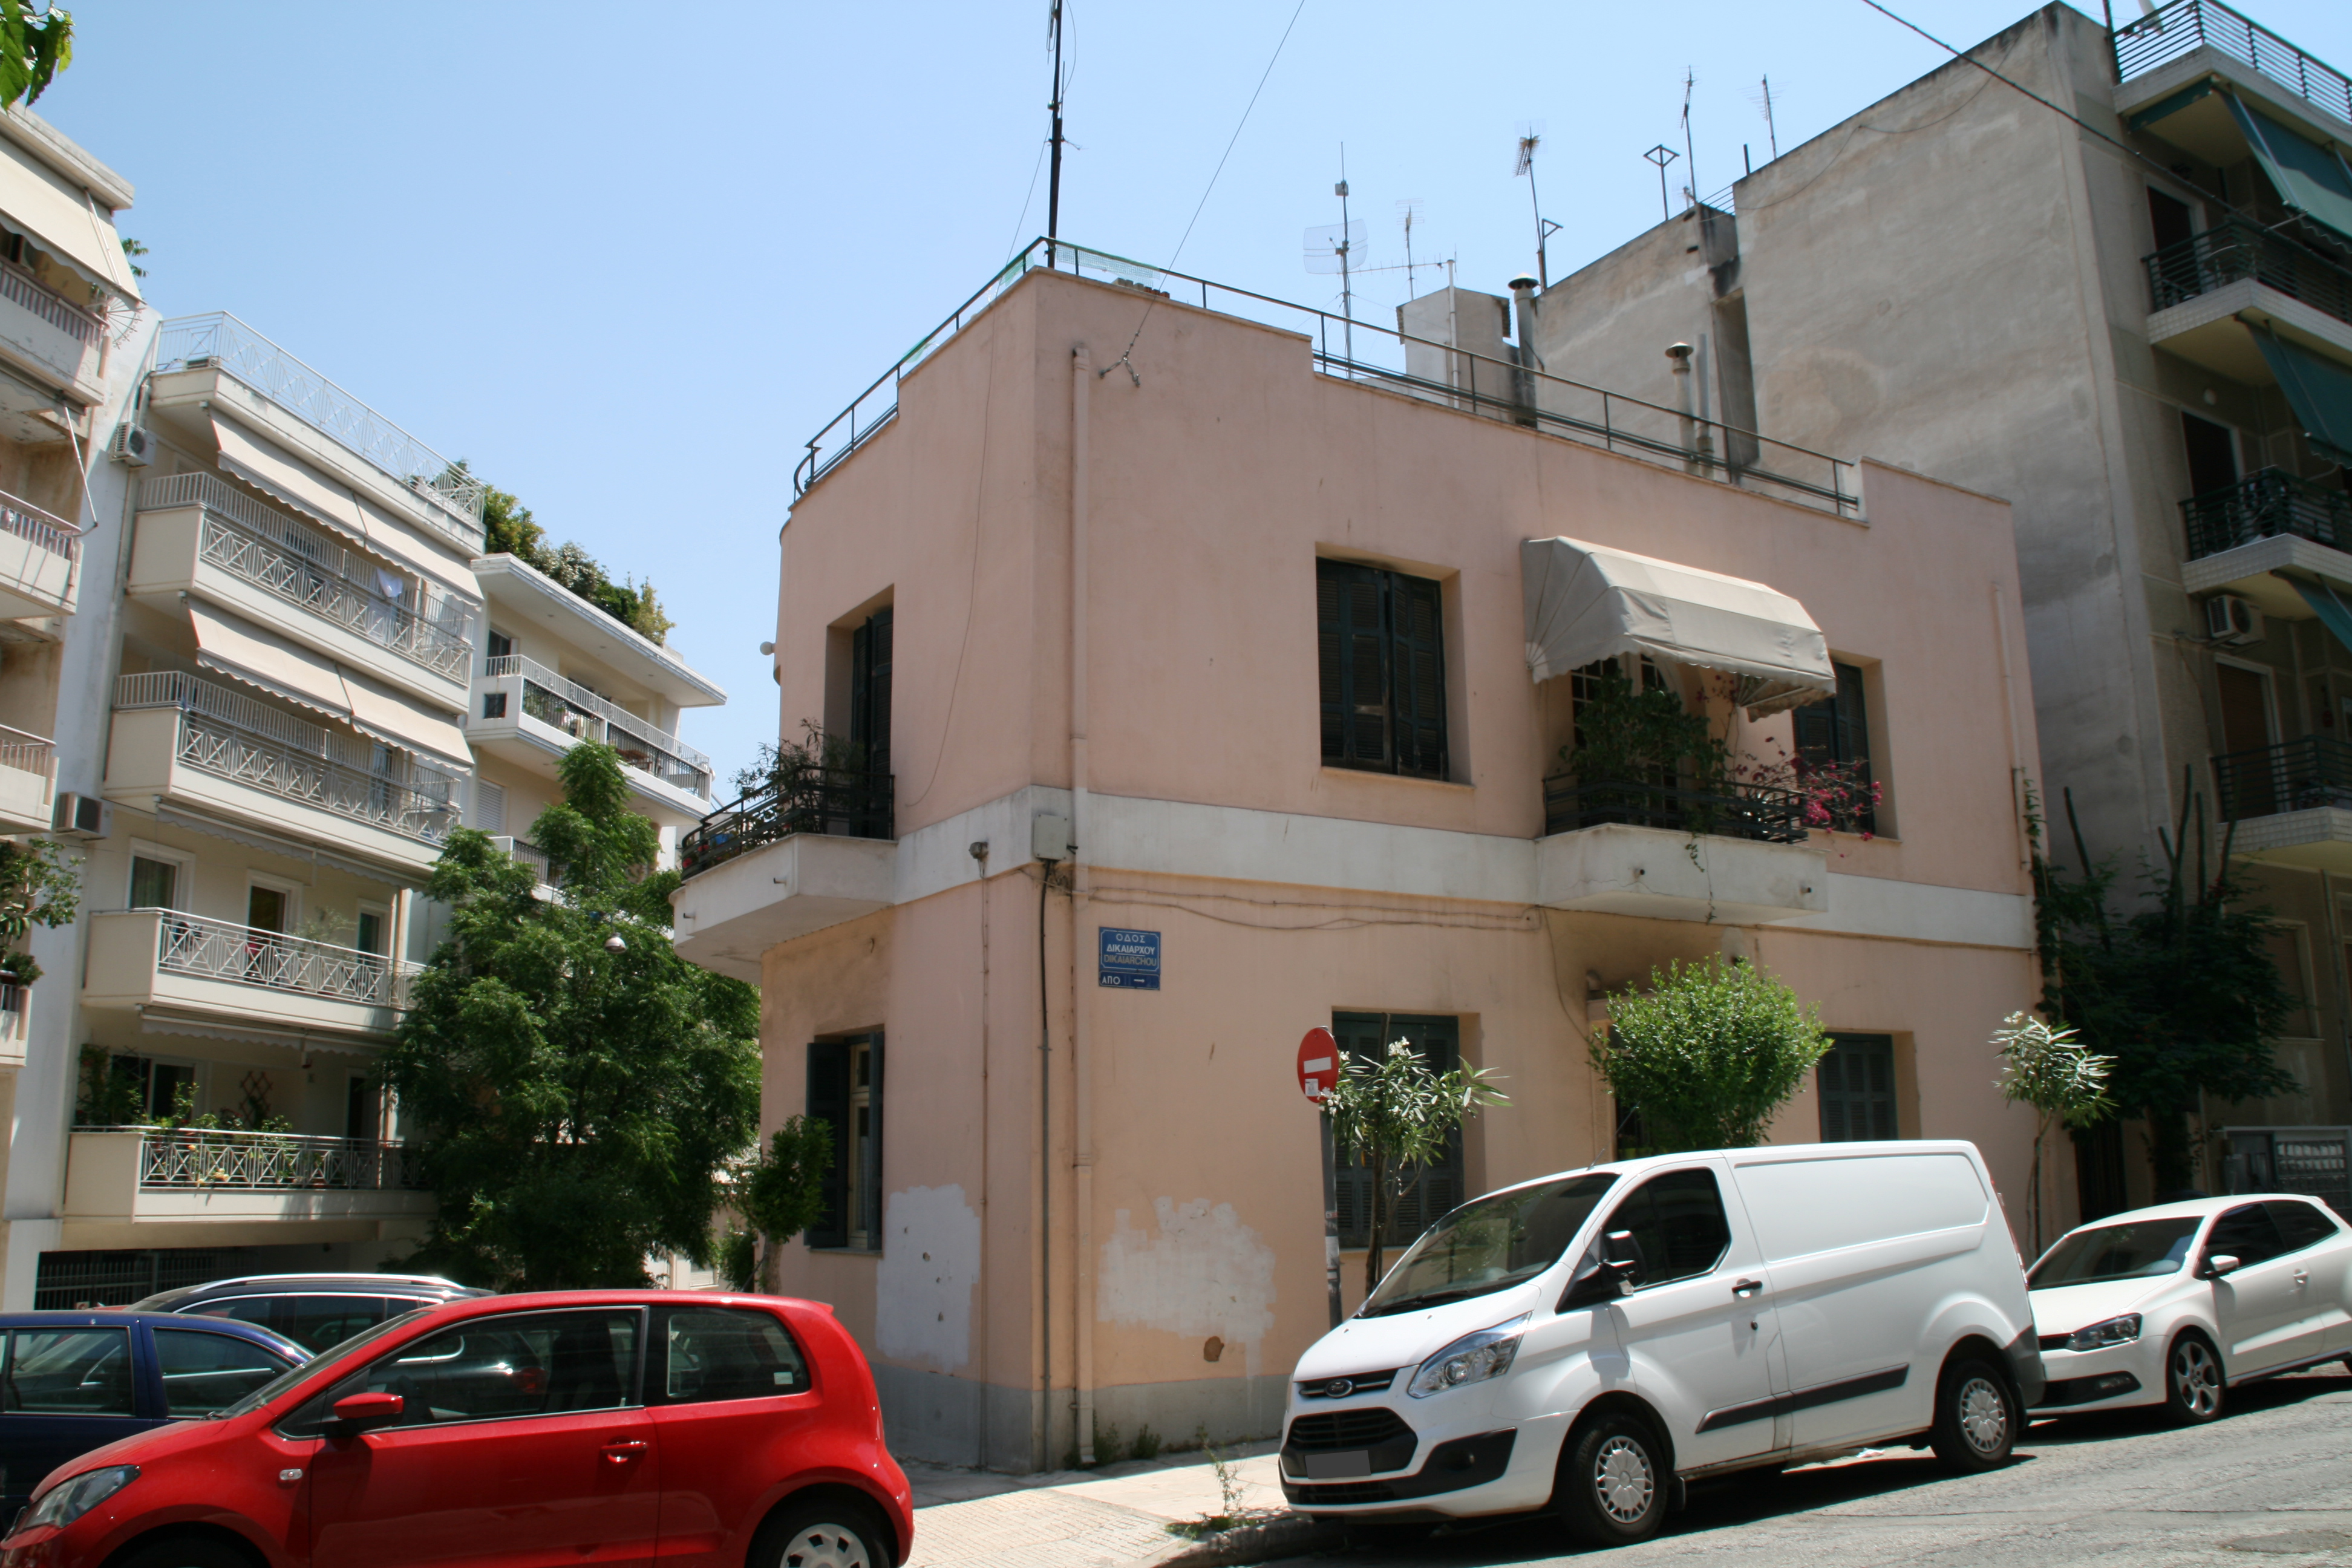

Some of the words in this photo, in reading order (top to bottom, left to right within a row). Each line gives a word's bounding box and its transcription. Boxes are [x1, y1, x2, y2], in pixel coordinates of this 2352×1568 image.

[1116, 933, 1145, 943] ΟΔΟΣ
[1106, 944, 1155, 955] ΔΙΚΑΙΑΡΧΟΥ
[1104, 955, 1156, 965] DIKAIARCHOU
[1102, 976, 1120, 984] ΑΠΟ
